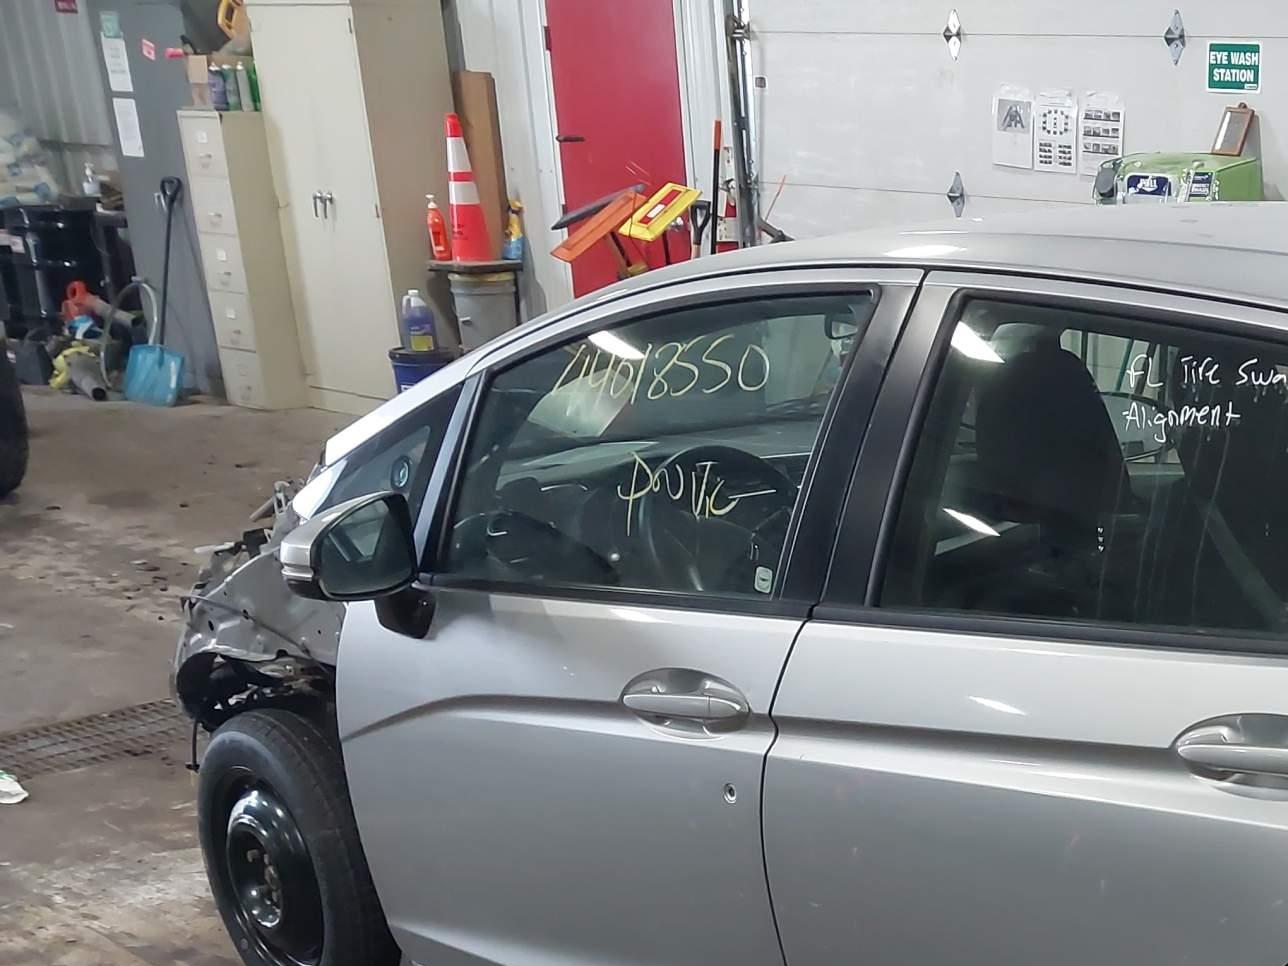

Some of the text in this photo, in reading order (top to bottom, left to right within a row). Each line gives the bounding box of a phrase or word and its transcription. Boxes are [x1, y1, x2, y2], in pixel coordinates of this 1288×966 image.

[1210, 51, 1259, 66] EYE WASH
[1213, 68, 1255, 82] STATION
[1180, 355, 1221, 387] Tire
